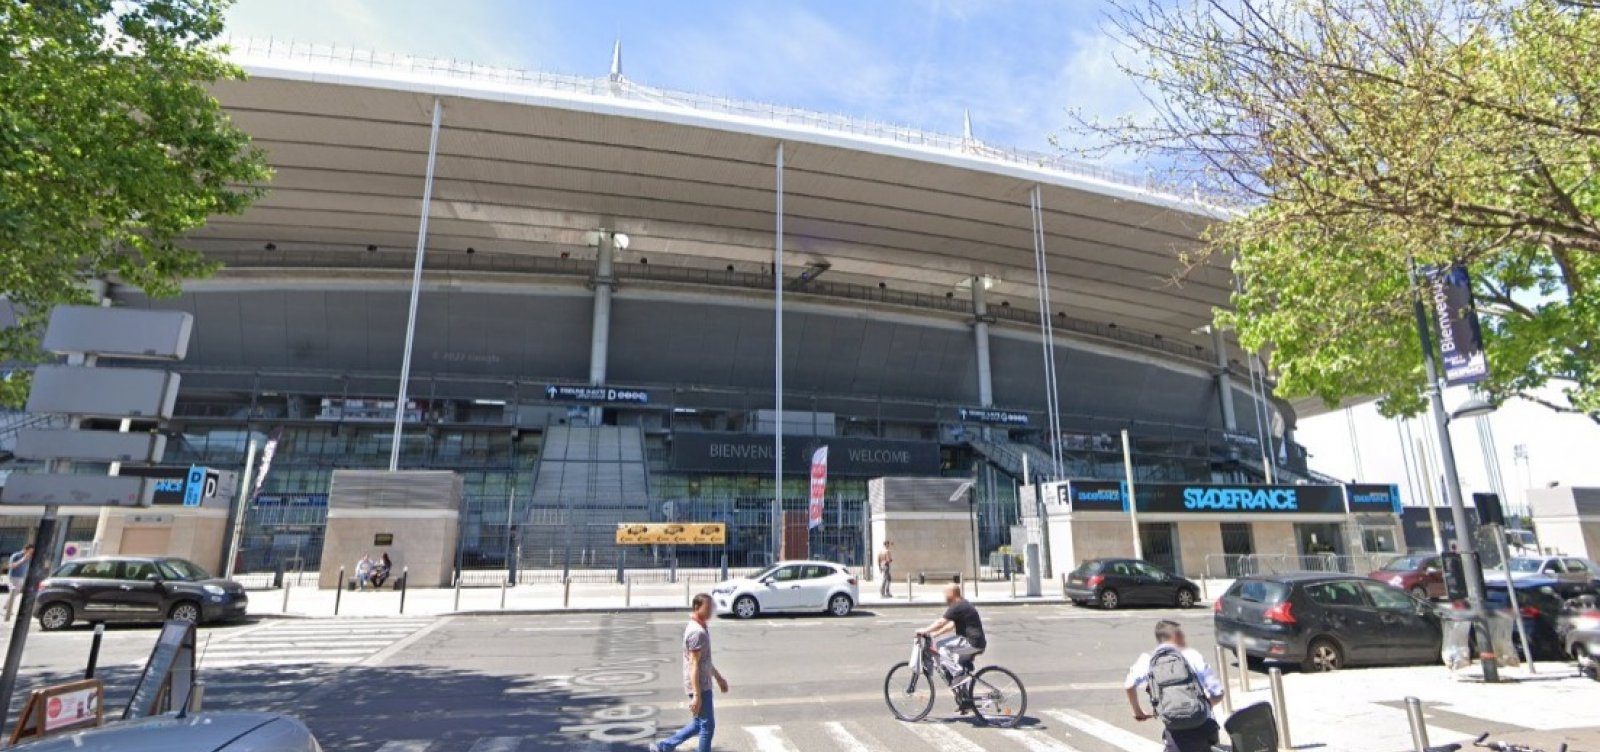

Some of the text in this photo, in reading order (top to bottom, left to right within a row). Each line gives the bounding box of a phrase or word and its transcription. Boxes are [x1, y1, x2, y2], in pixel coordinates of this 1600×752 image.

[709, 443, 786, 460] BIENVENUE
[849, 448, 911, 464] WELCOME
[205, 478, 217, 497] D
